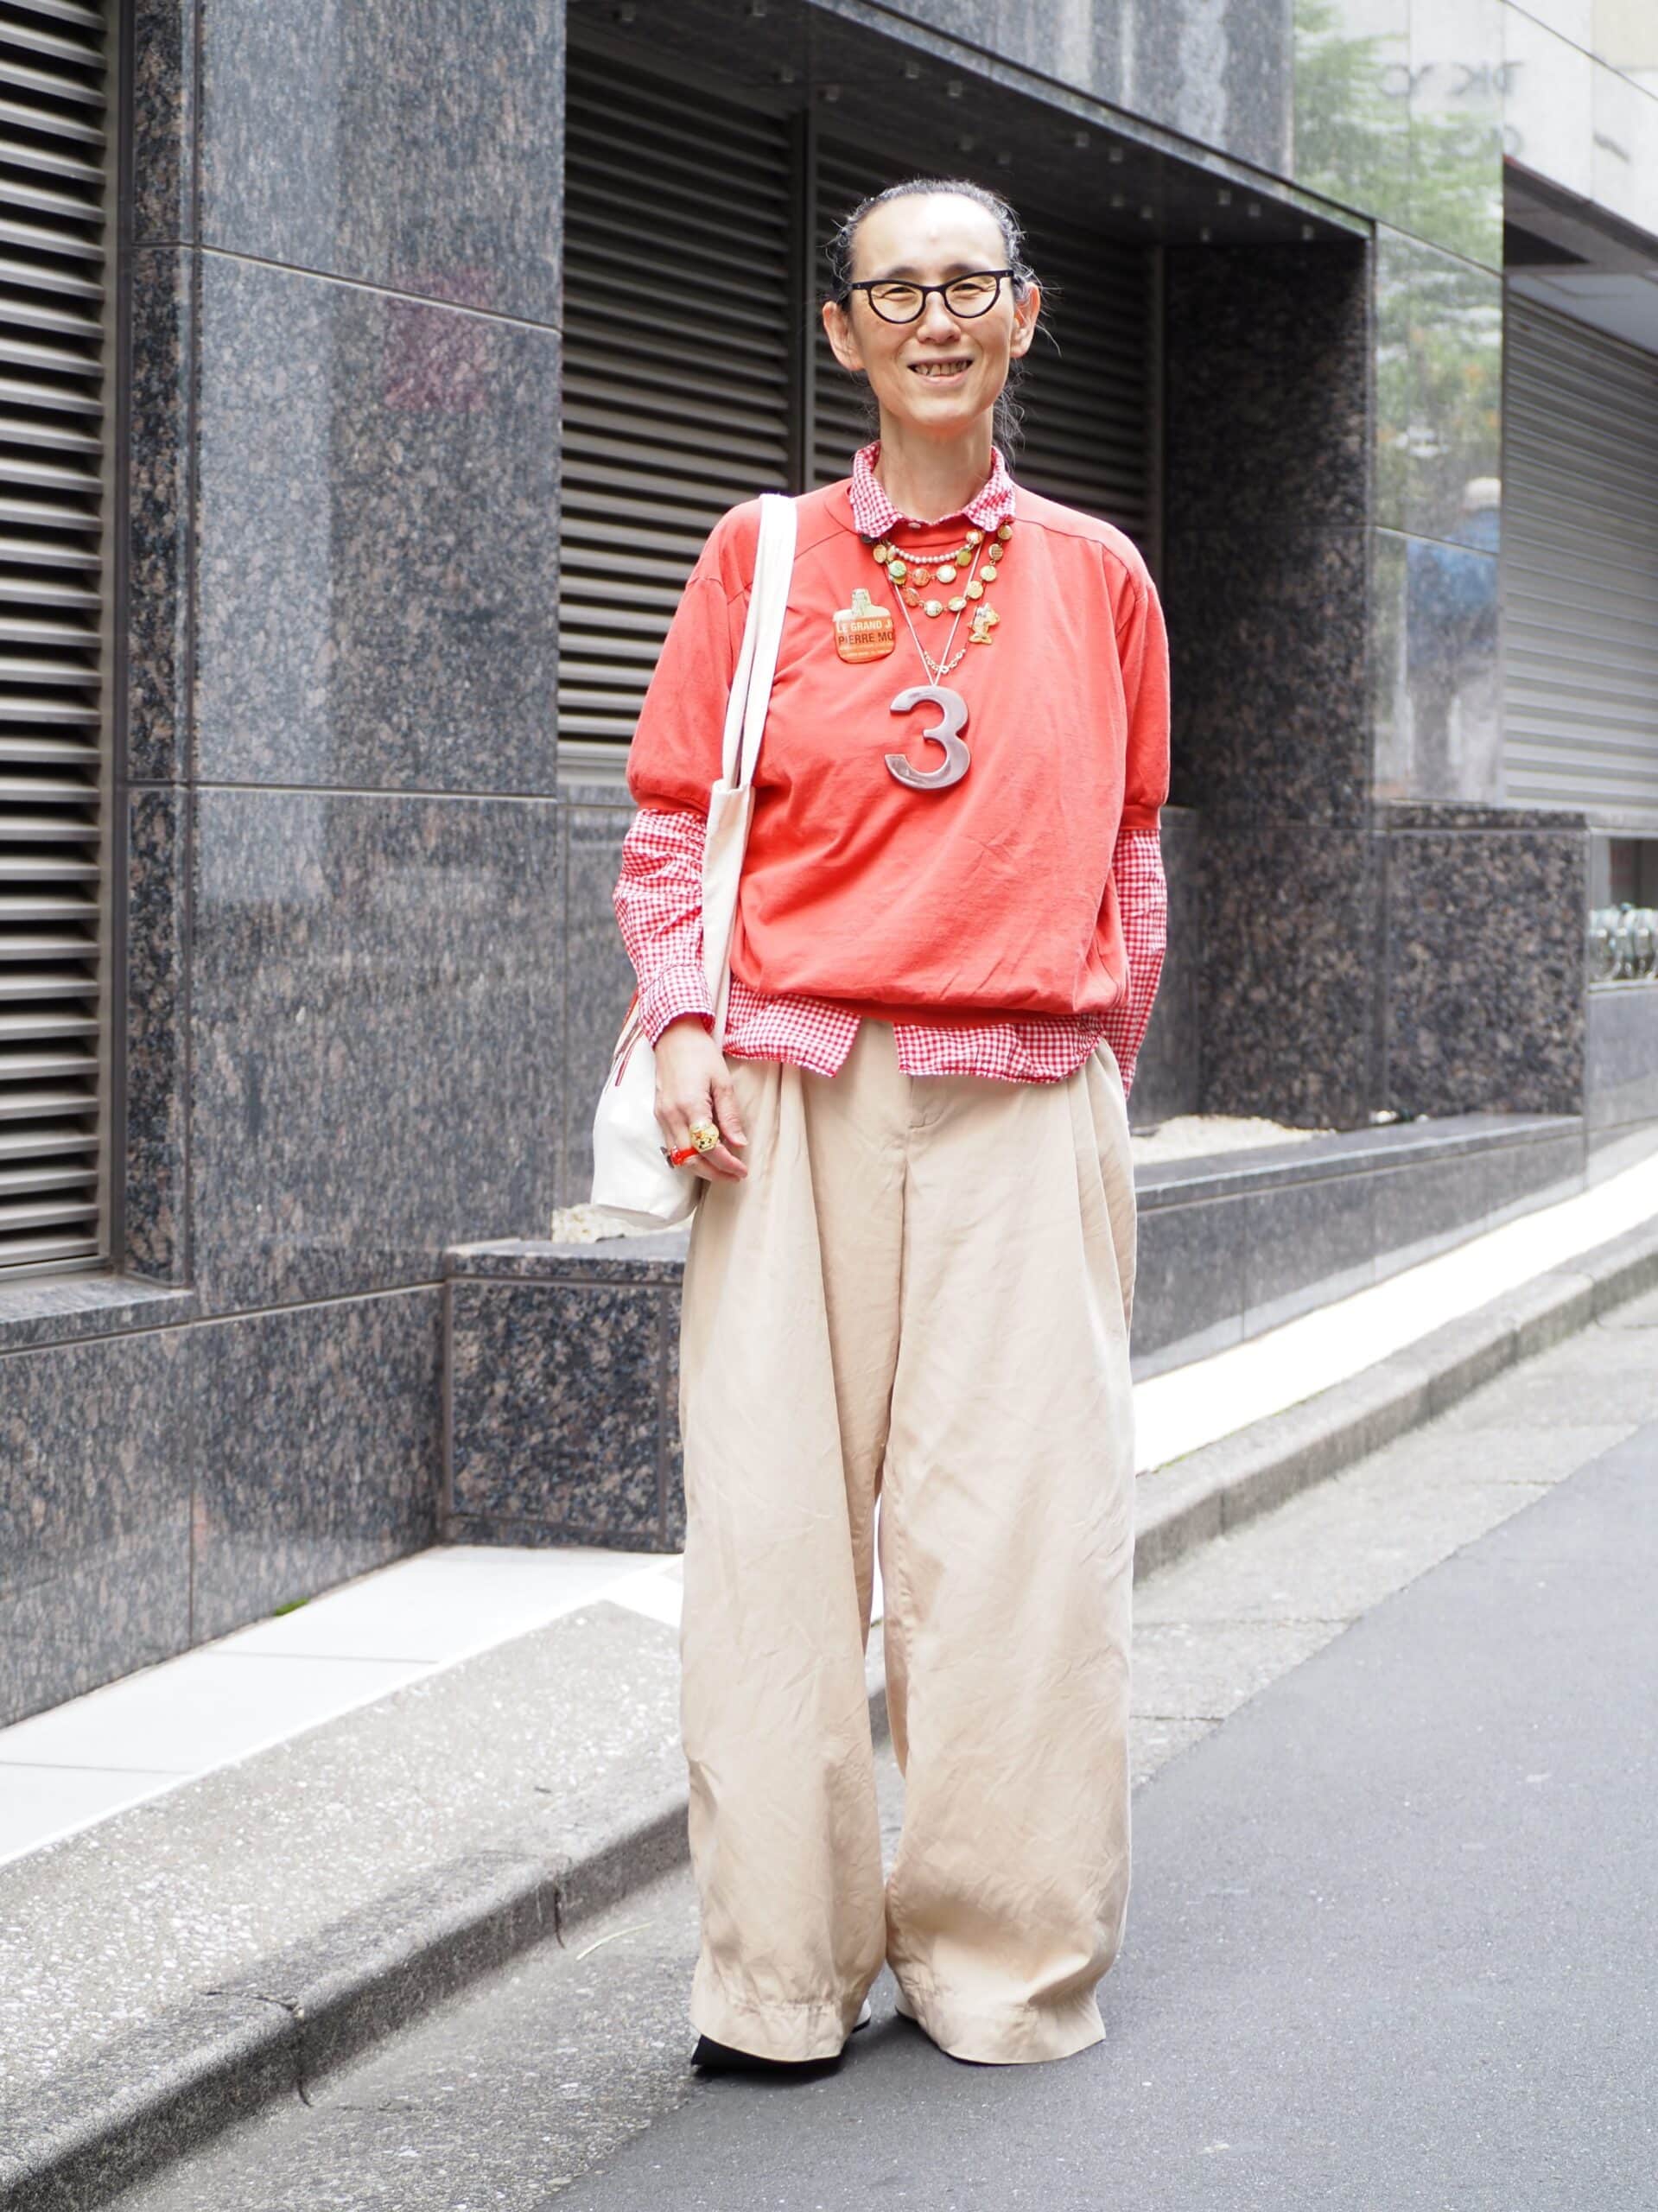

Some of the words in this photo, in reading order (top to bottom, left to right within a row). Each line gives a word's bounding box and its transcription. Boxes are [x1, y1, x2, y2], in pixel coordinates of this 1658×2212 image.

[851, 620, 882, 631] GRAND
[838, 632, 874, 645] PIERRE
[885, 685, 971, 790] 3
